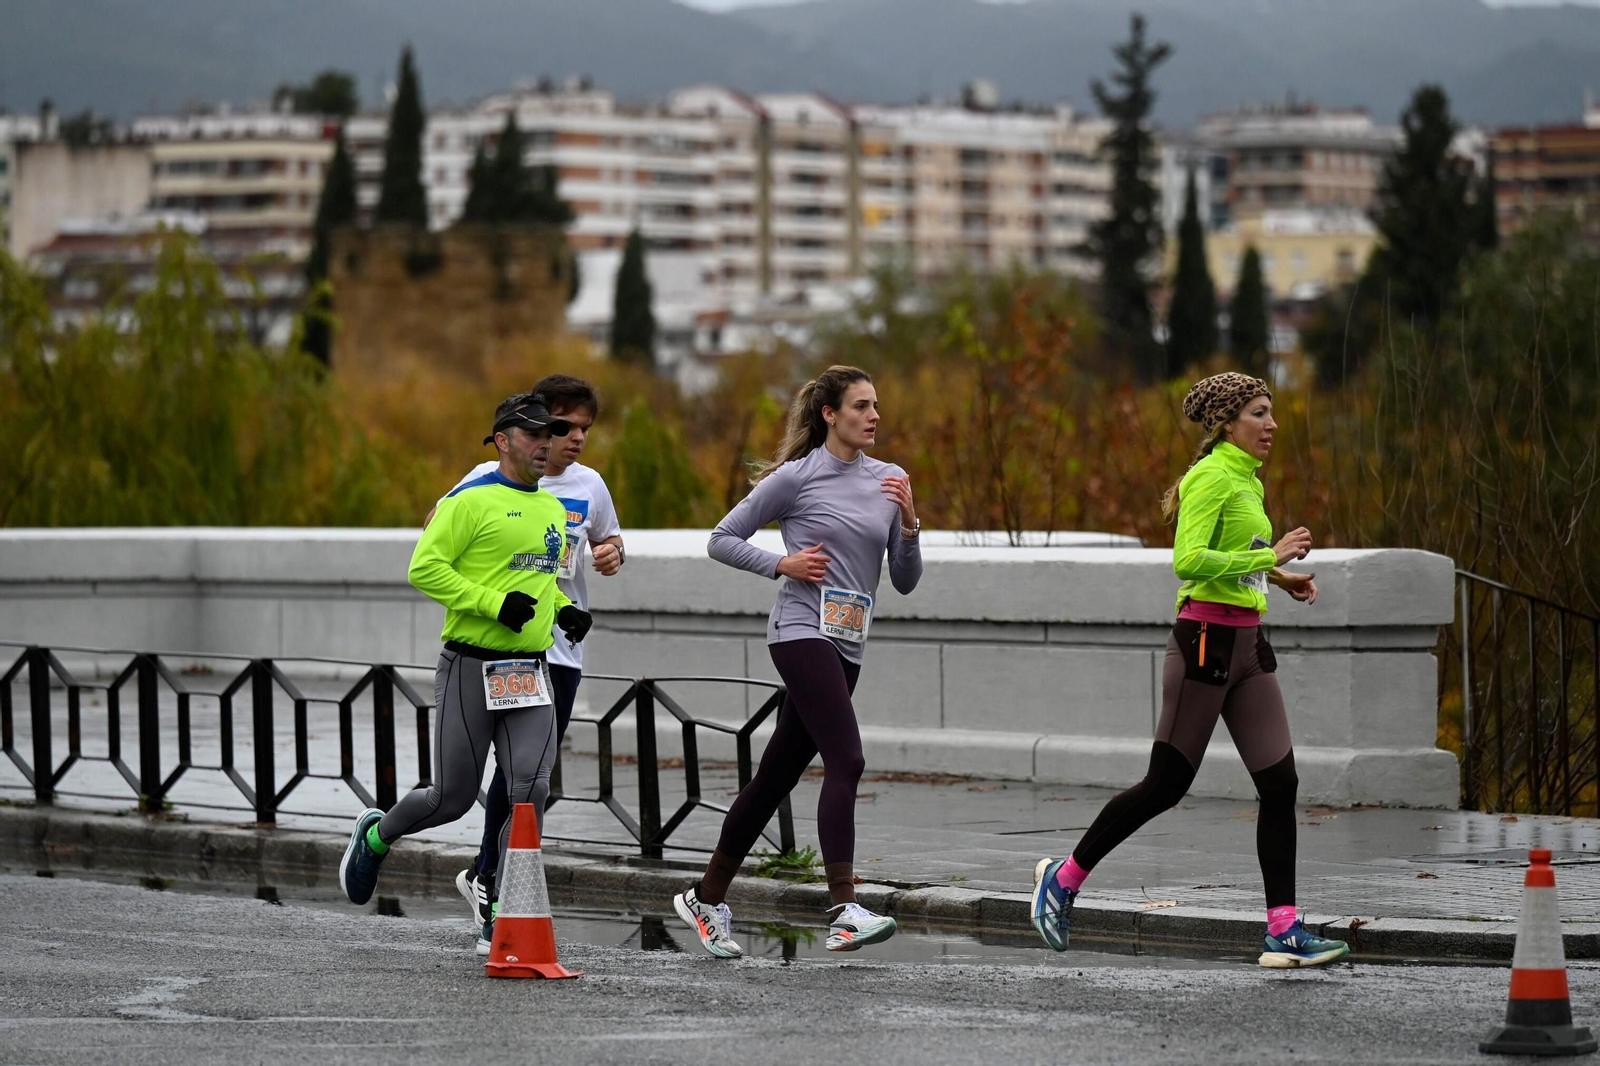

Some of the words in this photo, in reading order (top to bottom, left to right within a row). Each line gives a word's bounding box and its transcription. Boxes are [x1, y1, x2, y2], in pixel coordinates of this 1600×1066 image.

[507, 510, 522, 518] vive
[824, 601, 864, 630] 220
[488, 673, 537, 697] 360
[688, 896, 720, 946] HYROX
